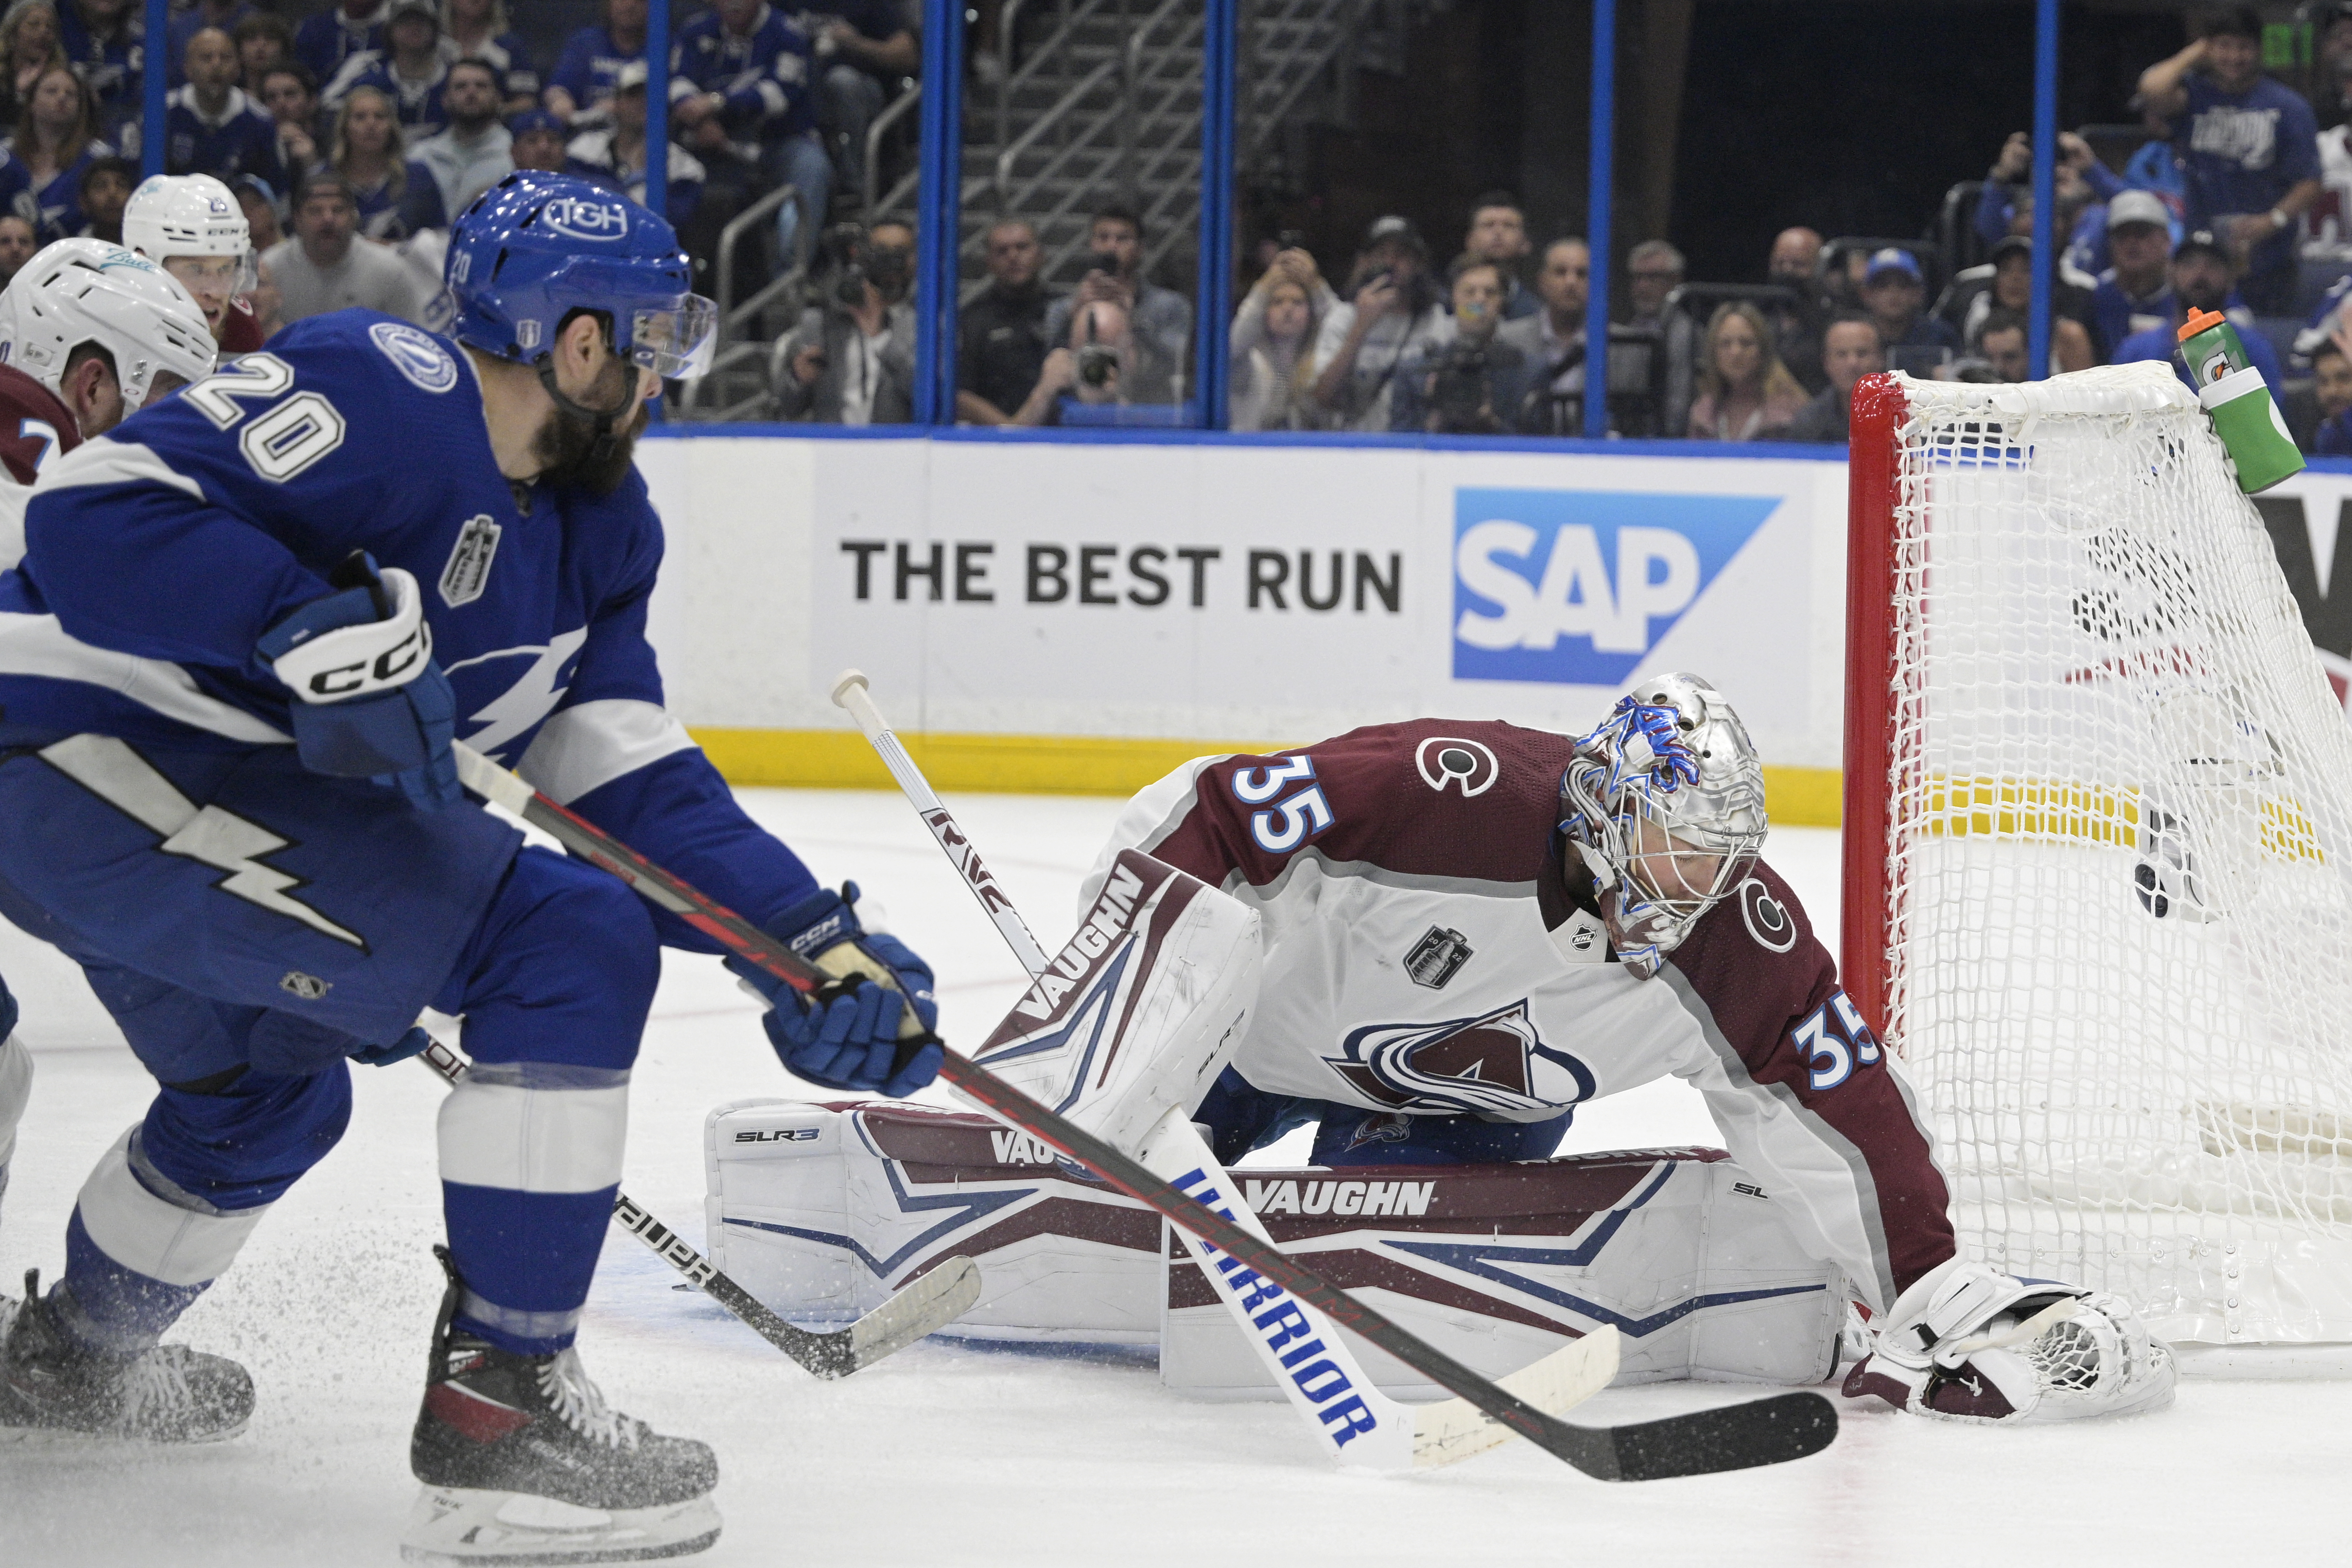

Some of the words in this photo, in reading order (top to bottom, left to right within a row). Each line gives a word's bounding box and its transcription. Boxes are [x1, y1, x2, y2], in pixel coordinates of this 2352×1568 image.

[558, 198, 627, 235] TGH
[453, 250, 472, 284] 20
[179, 351, 347, 484] 20
[840, 541, 995, 603] THE
[1027, 543, 1220, 609] BEST
[1248, 549, 1402, 613] RUN
[1456, 519, 1701, 654] SAP
[310, 628, 428, 694] CC
[1232, 754, 1335, 854] 35
[791, 915, 841, 950] CCM
[1016, 863, 1144, 1020] VAUGHN
[1428, 936, 1439, 945] 20
[1573, 932, 1596, 943] NHL
[1452, 953, 1463, 962] 22
[1792, 989, 1881, 1091] 35
[735, 1129, 819, 1143] SLR3
[1245, 1180, 1435, 1215] VAUGHN
[1732, 1182, 1769, 1200] SL
[615, 1193, 718, 1288] AUER
